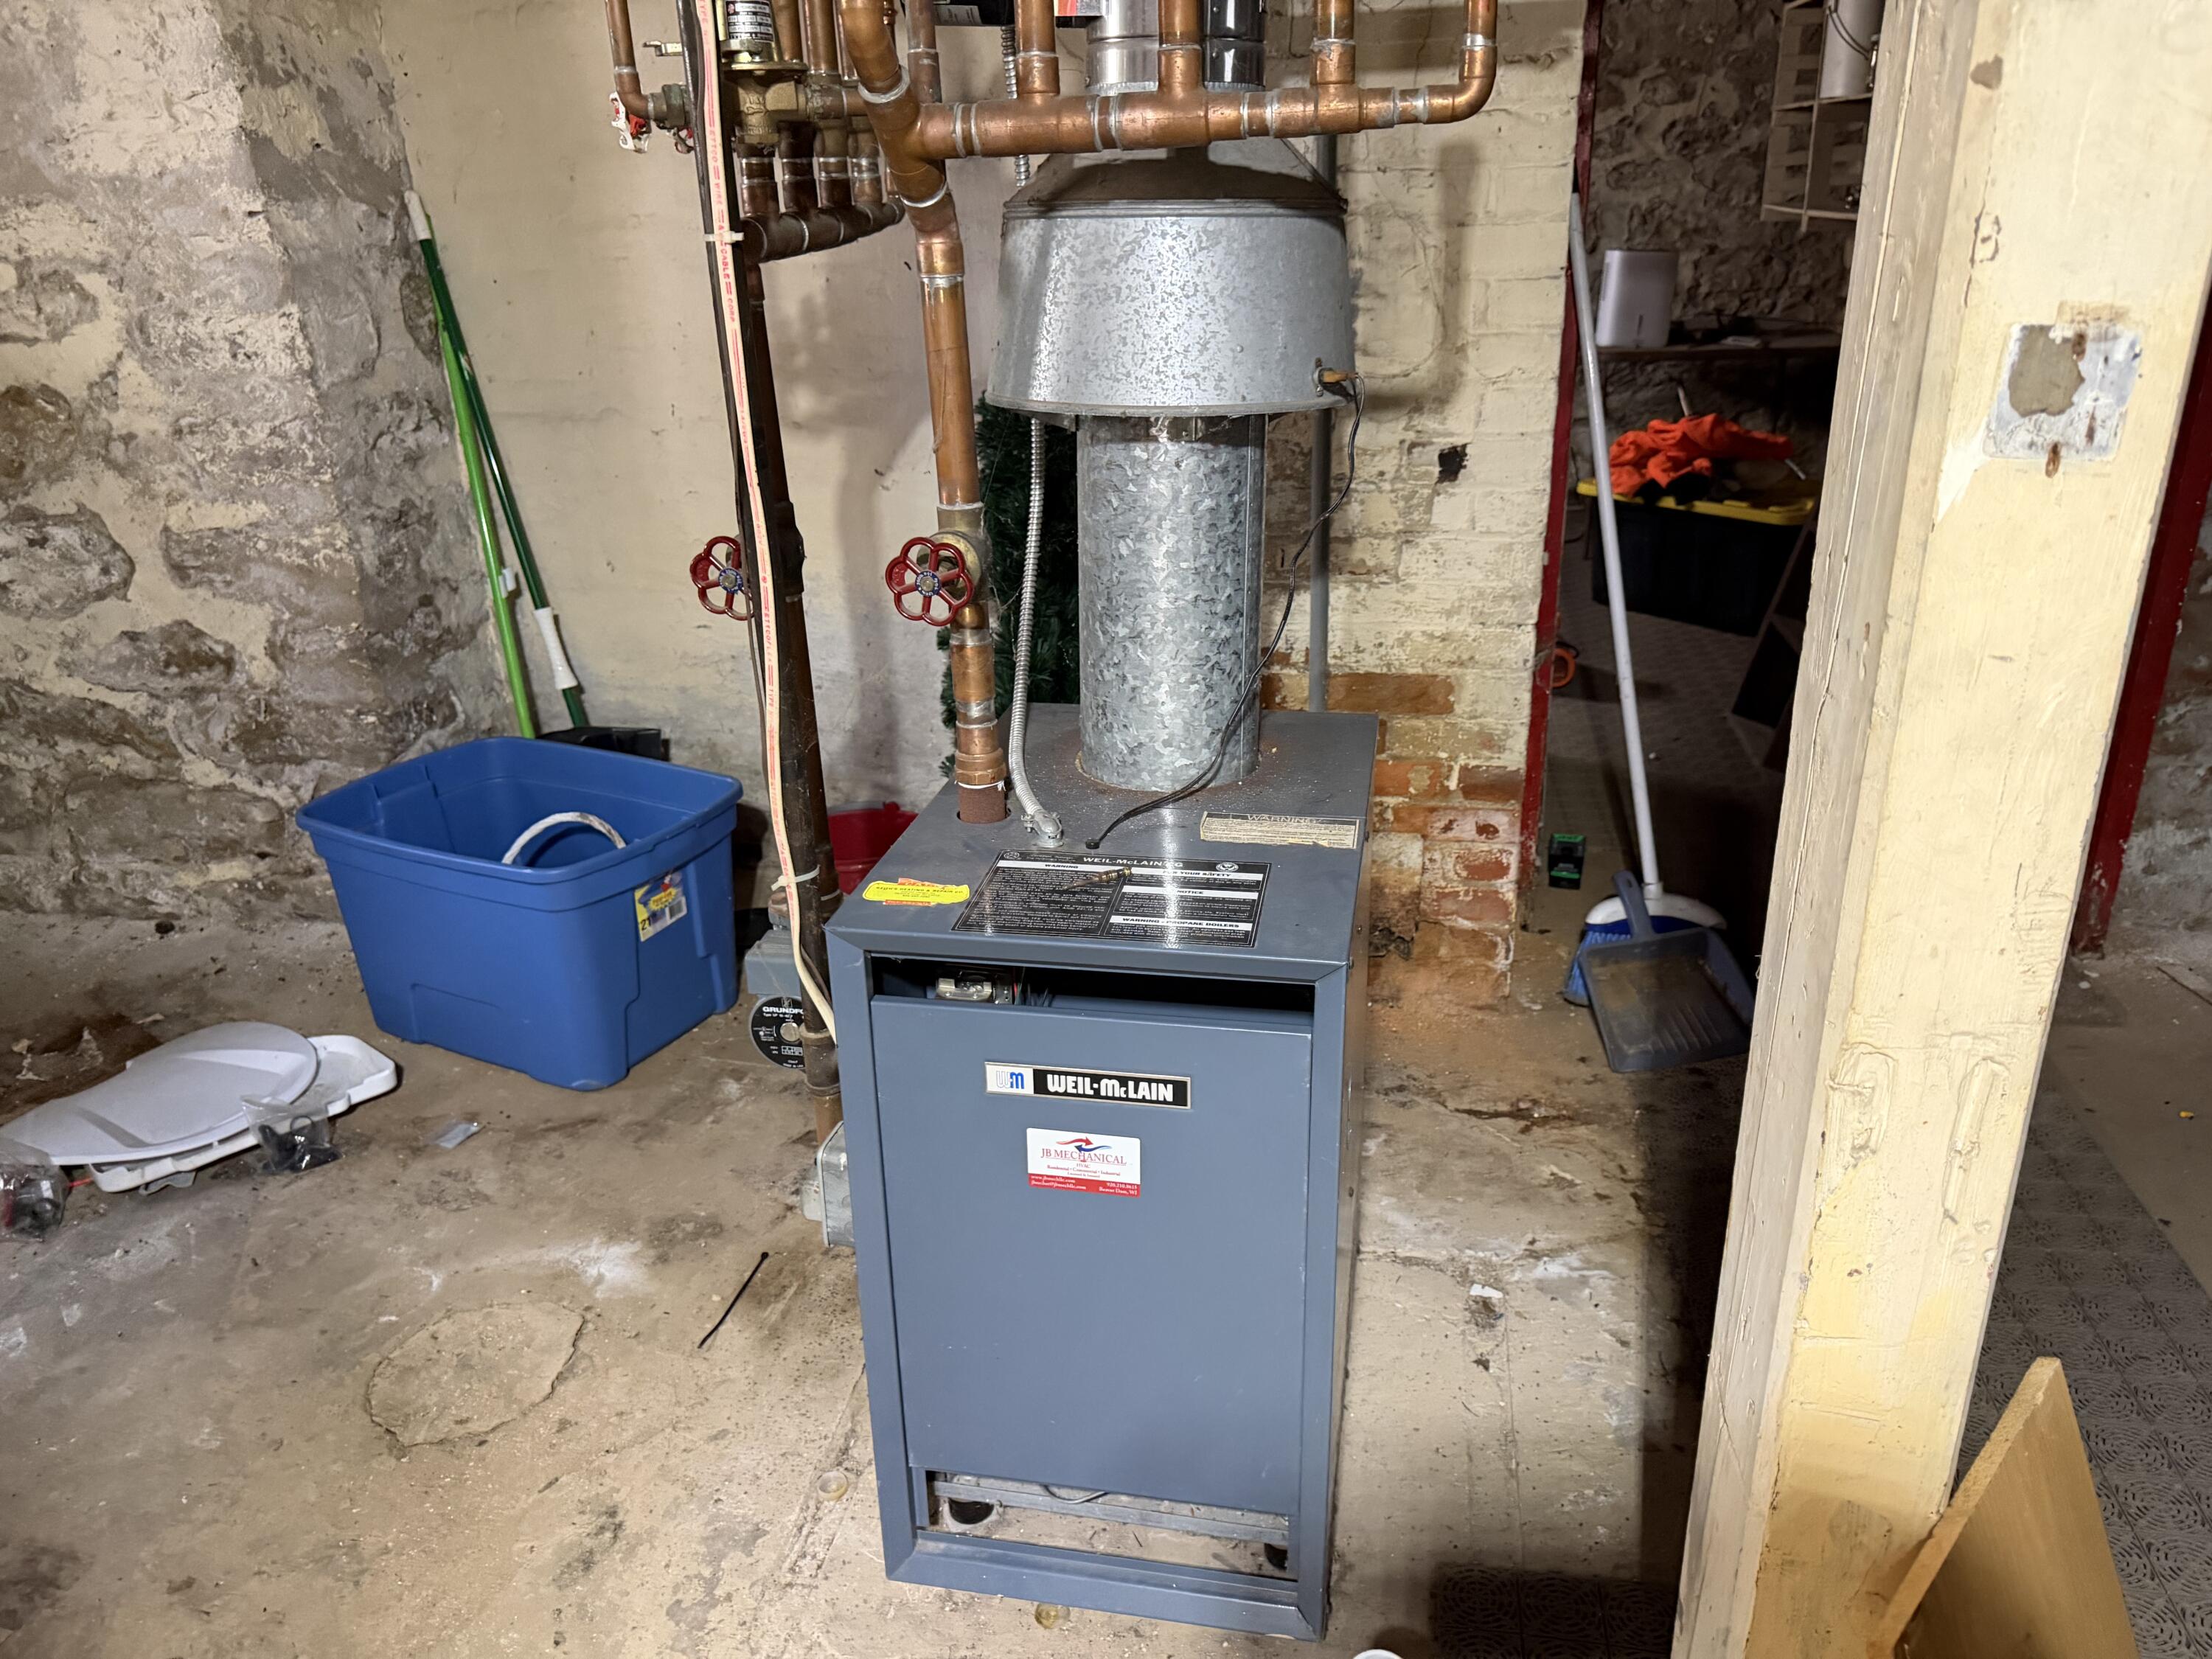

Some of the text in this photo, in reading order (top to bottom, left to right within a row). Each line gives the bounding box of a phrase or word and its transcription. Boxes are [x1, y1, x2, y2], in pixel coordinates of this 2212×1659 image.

[721, 248, 731, 279] CABLE
[727, 298, 735, 322] CORP
[1083, 857, 1163, 866] WEIL-McLAIN
[1046, 1074, 1174, 1102] WEIL-McLAIN
[1040, 1148, 1127, 1164] JB MECHANICAL
